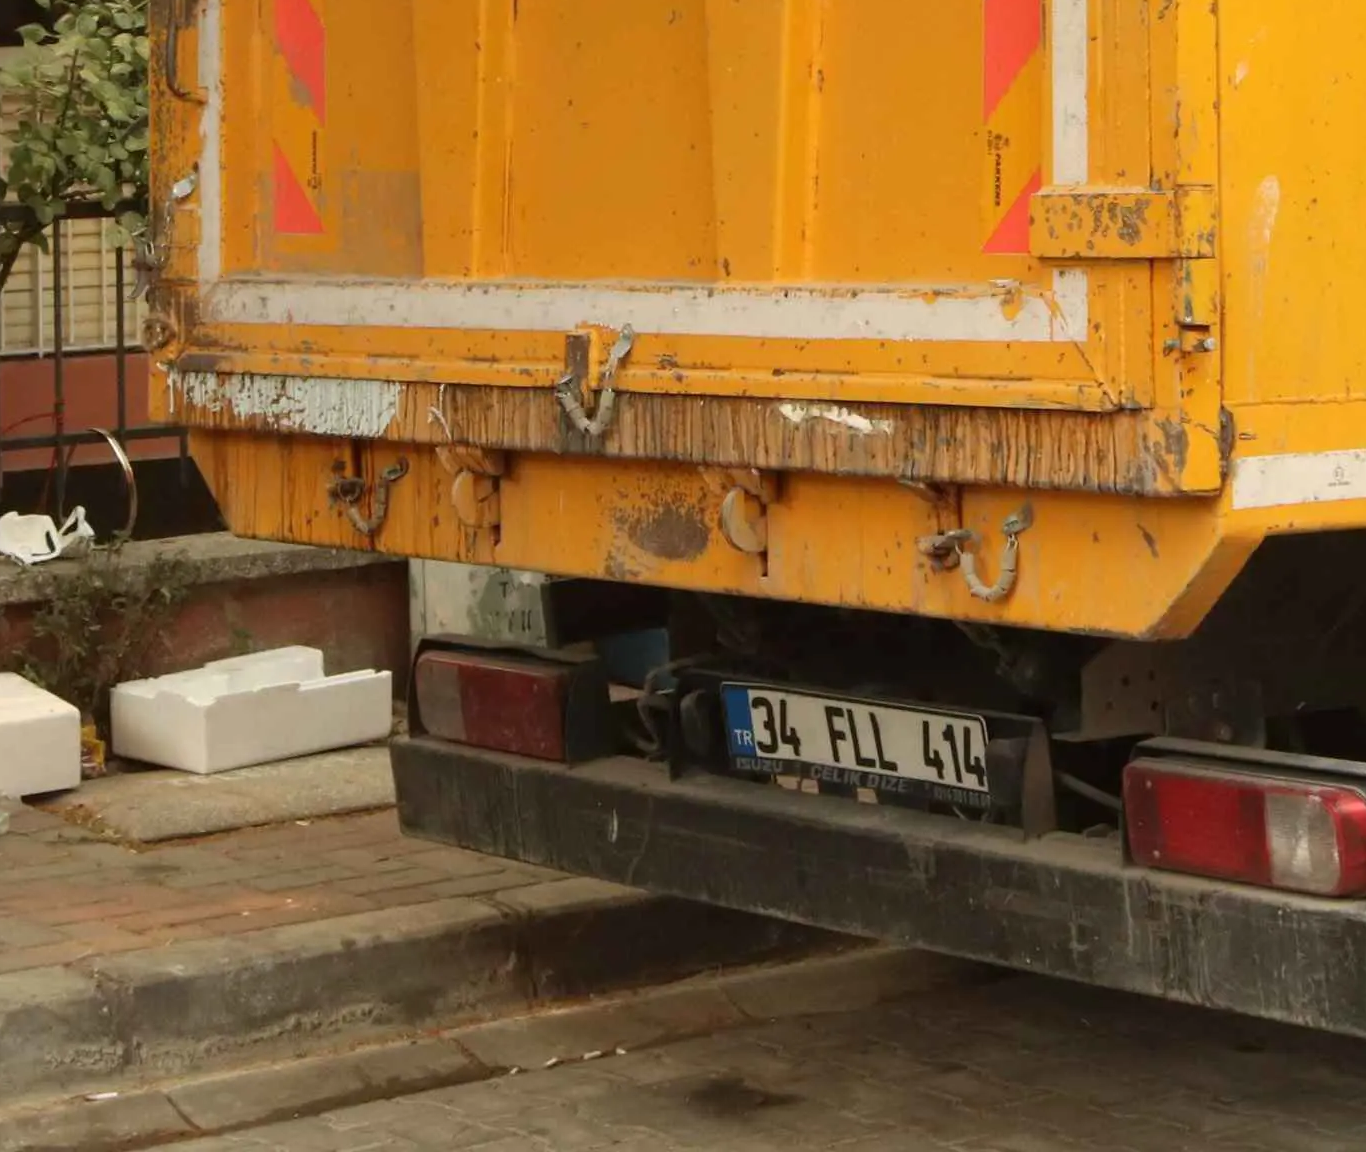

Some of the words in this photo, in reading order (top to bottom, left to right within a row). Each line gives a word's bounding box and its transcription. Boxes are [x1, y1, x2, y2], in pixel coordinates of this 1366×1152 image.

[734, 729, 753, 746] TR
[752, 696, 801, 756] 34
[825, 706, 898, 772] FLL
[922, 719, 988, 787] 414
[736, 757, 784, 773] ISUZU
